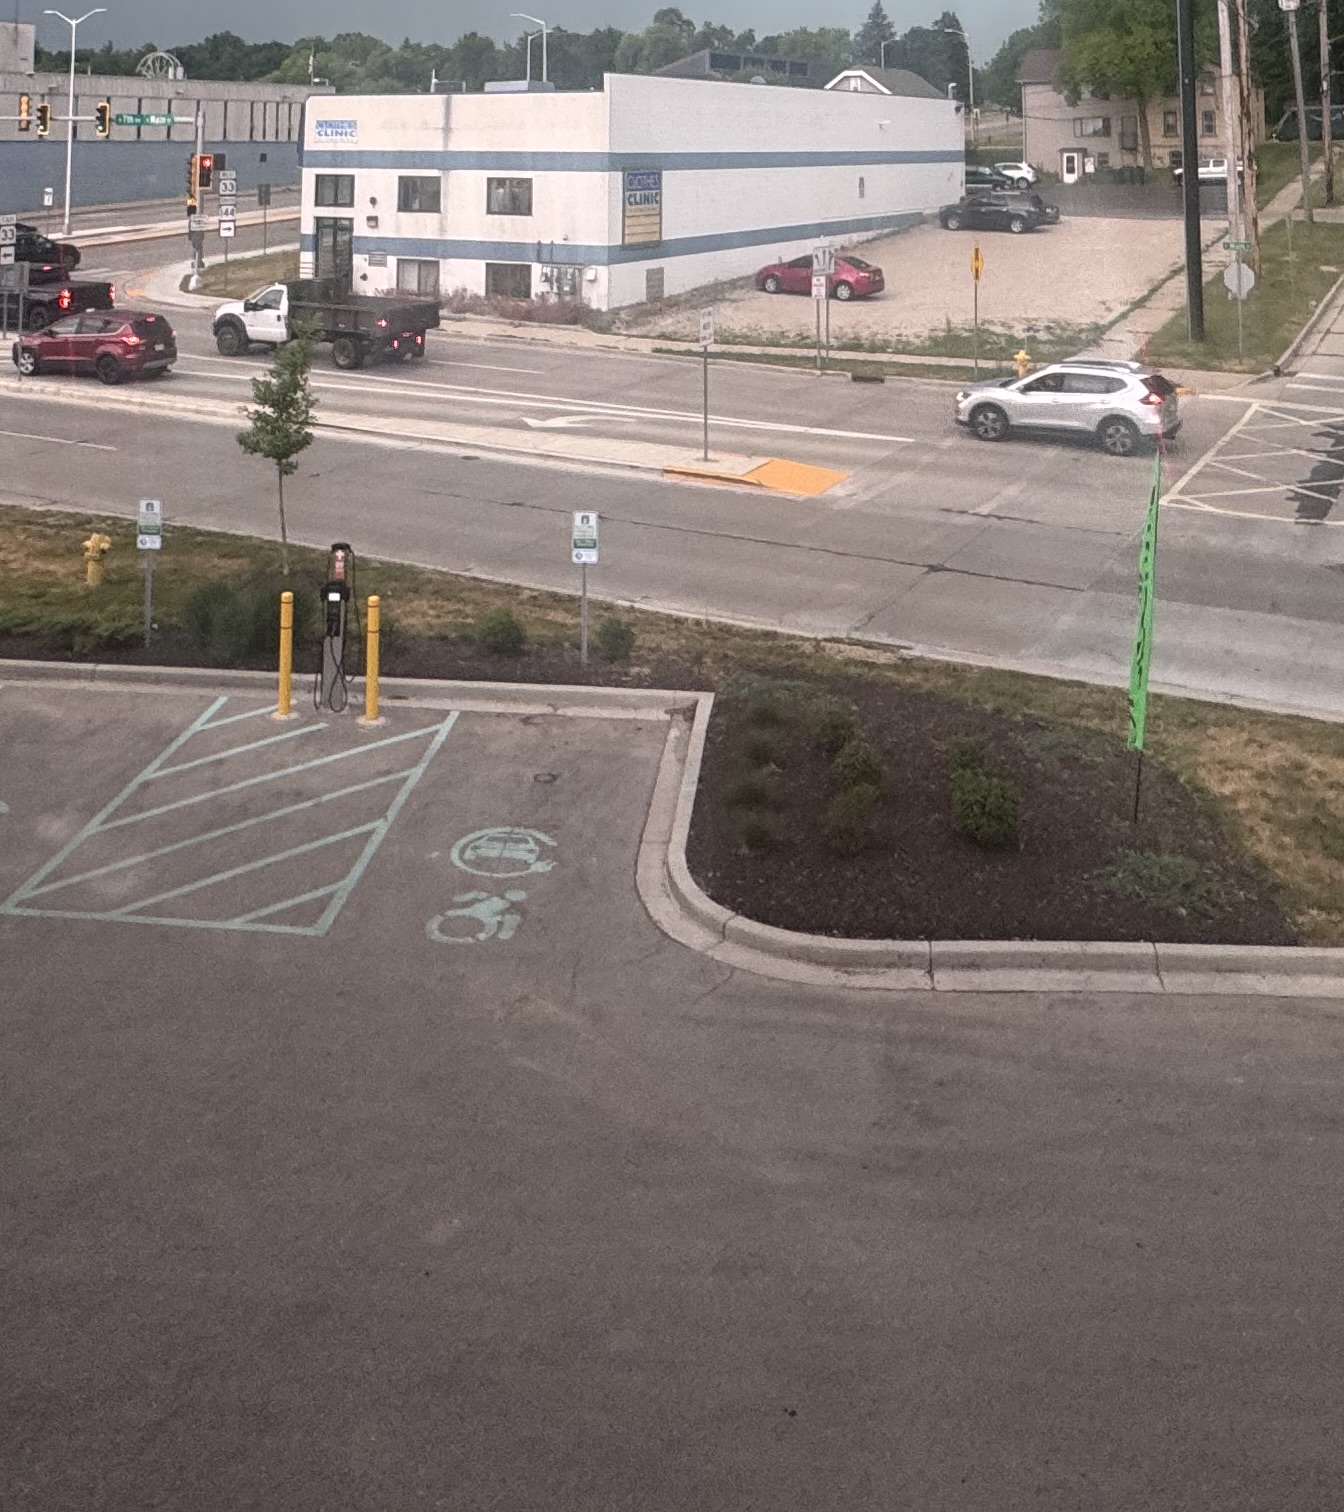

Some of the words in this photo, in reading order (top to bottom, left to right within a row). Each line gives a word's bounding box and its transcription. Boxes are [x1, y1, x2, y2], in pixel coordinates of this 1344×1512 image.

[316, 129, 356, 138] CLINIC
[221, 182, 235, 192] 33
[627, 192, 659, 206] CLINIC
[1, 228, 15, 241] 33
